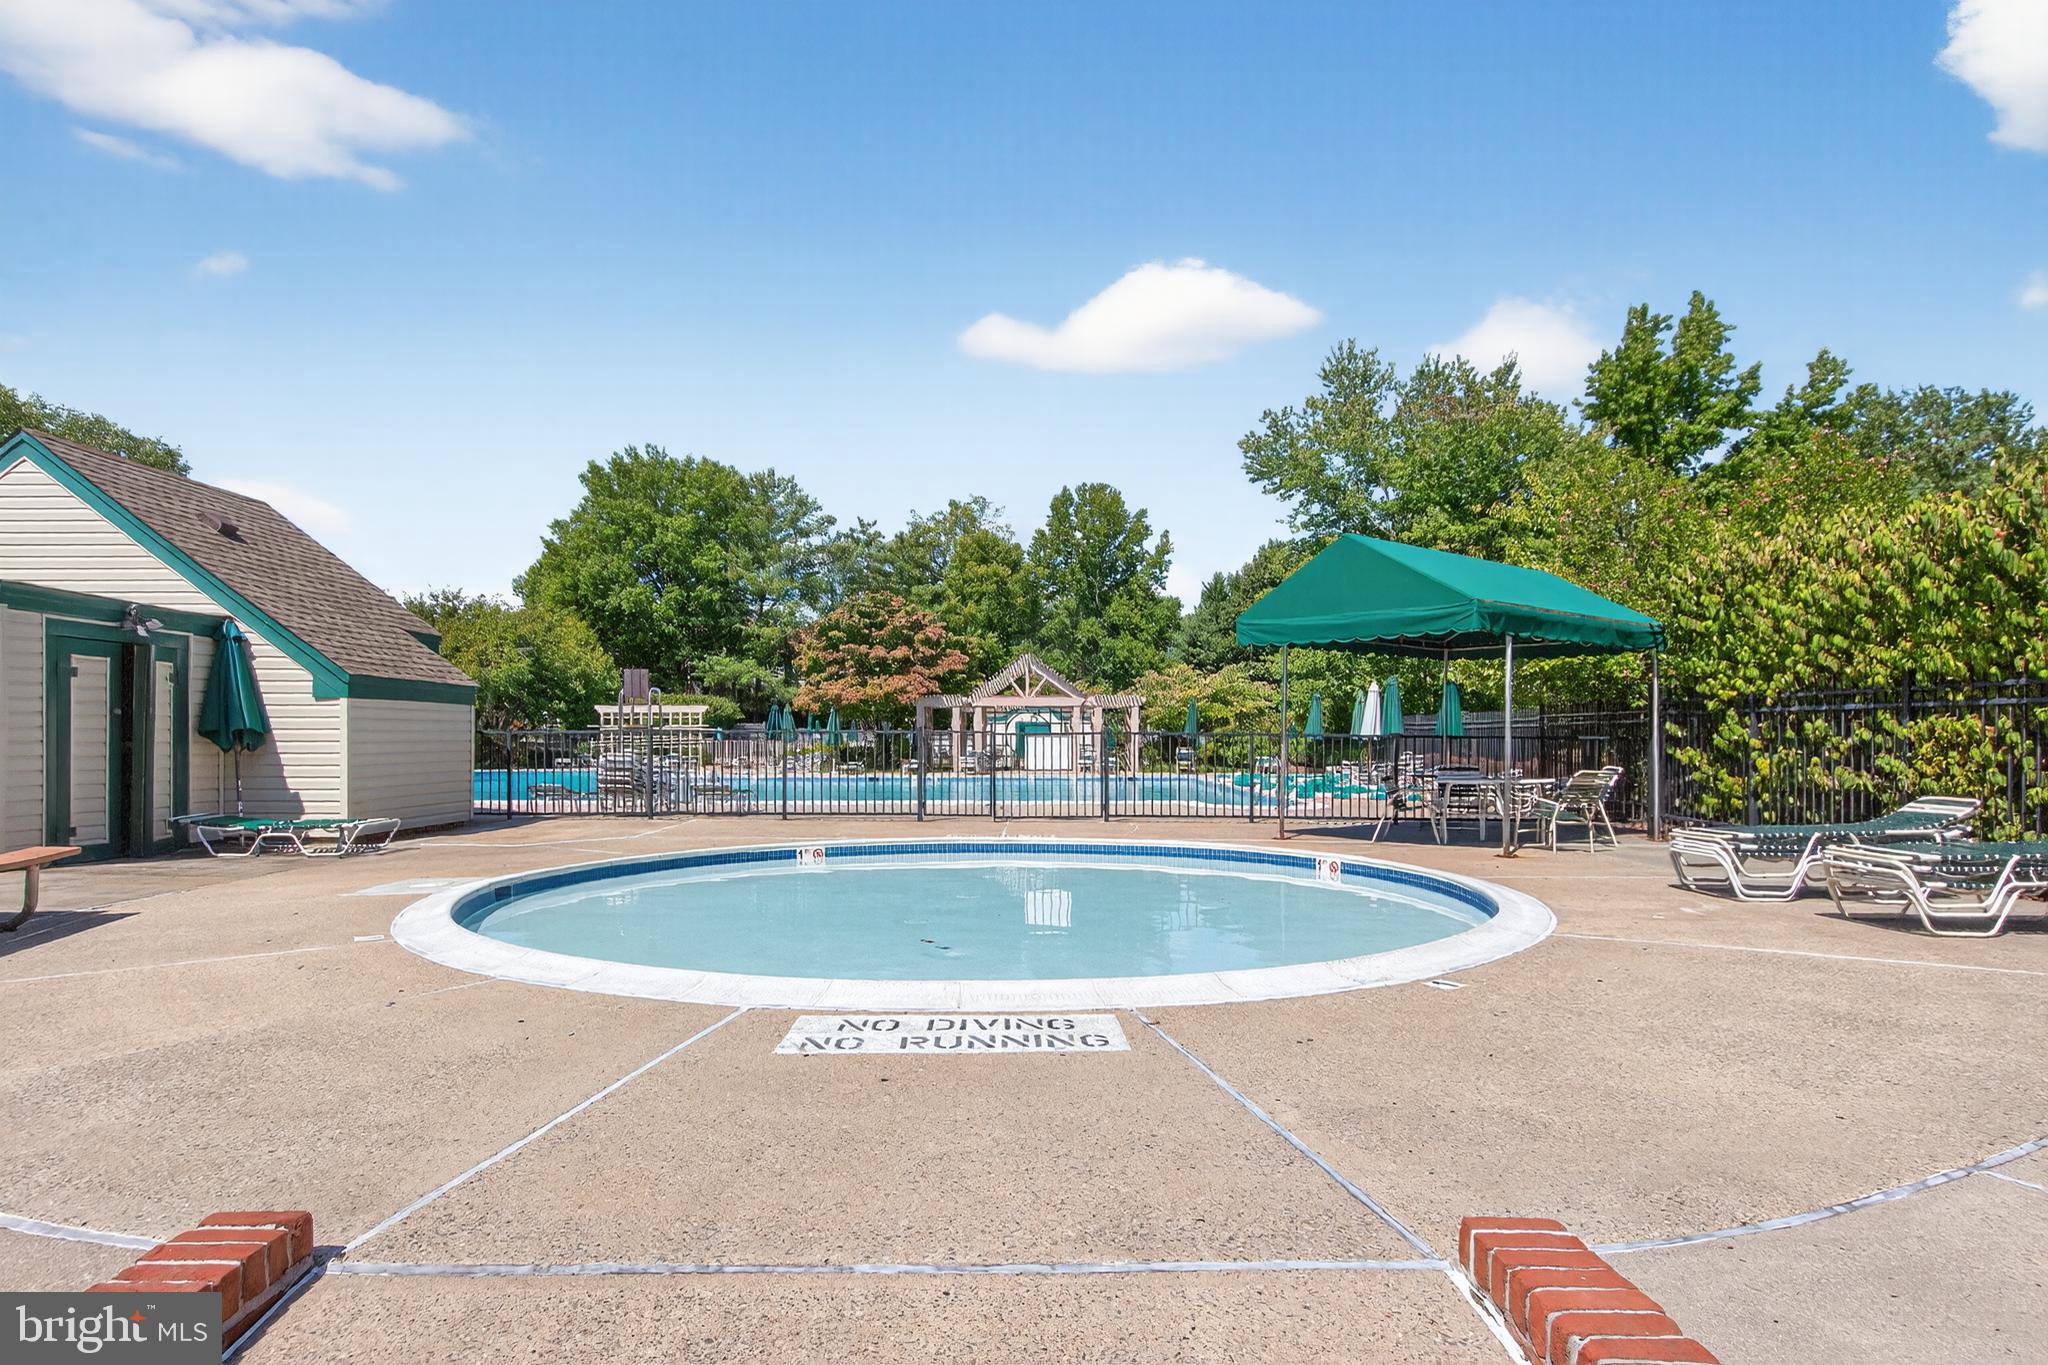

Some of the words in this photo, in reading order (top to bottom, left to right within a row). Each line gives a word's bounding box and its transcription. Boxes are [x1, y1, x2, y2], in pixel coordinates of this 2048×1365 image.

[837, 1018, 901, 1032] NO
[927, 1018, 1076, 1031] DIVING
[800, 1036, 866, 1050] NO
[899, 1035, 1111, 1050] RUNNING
